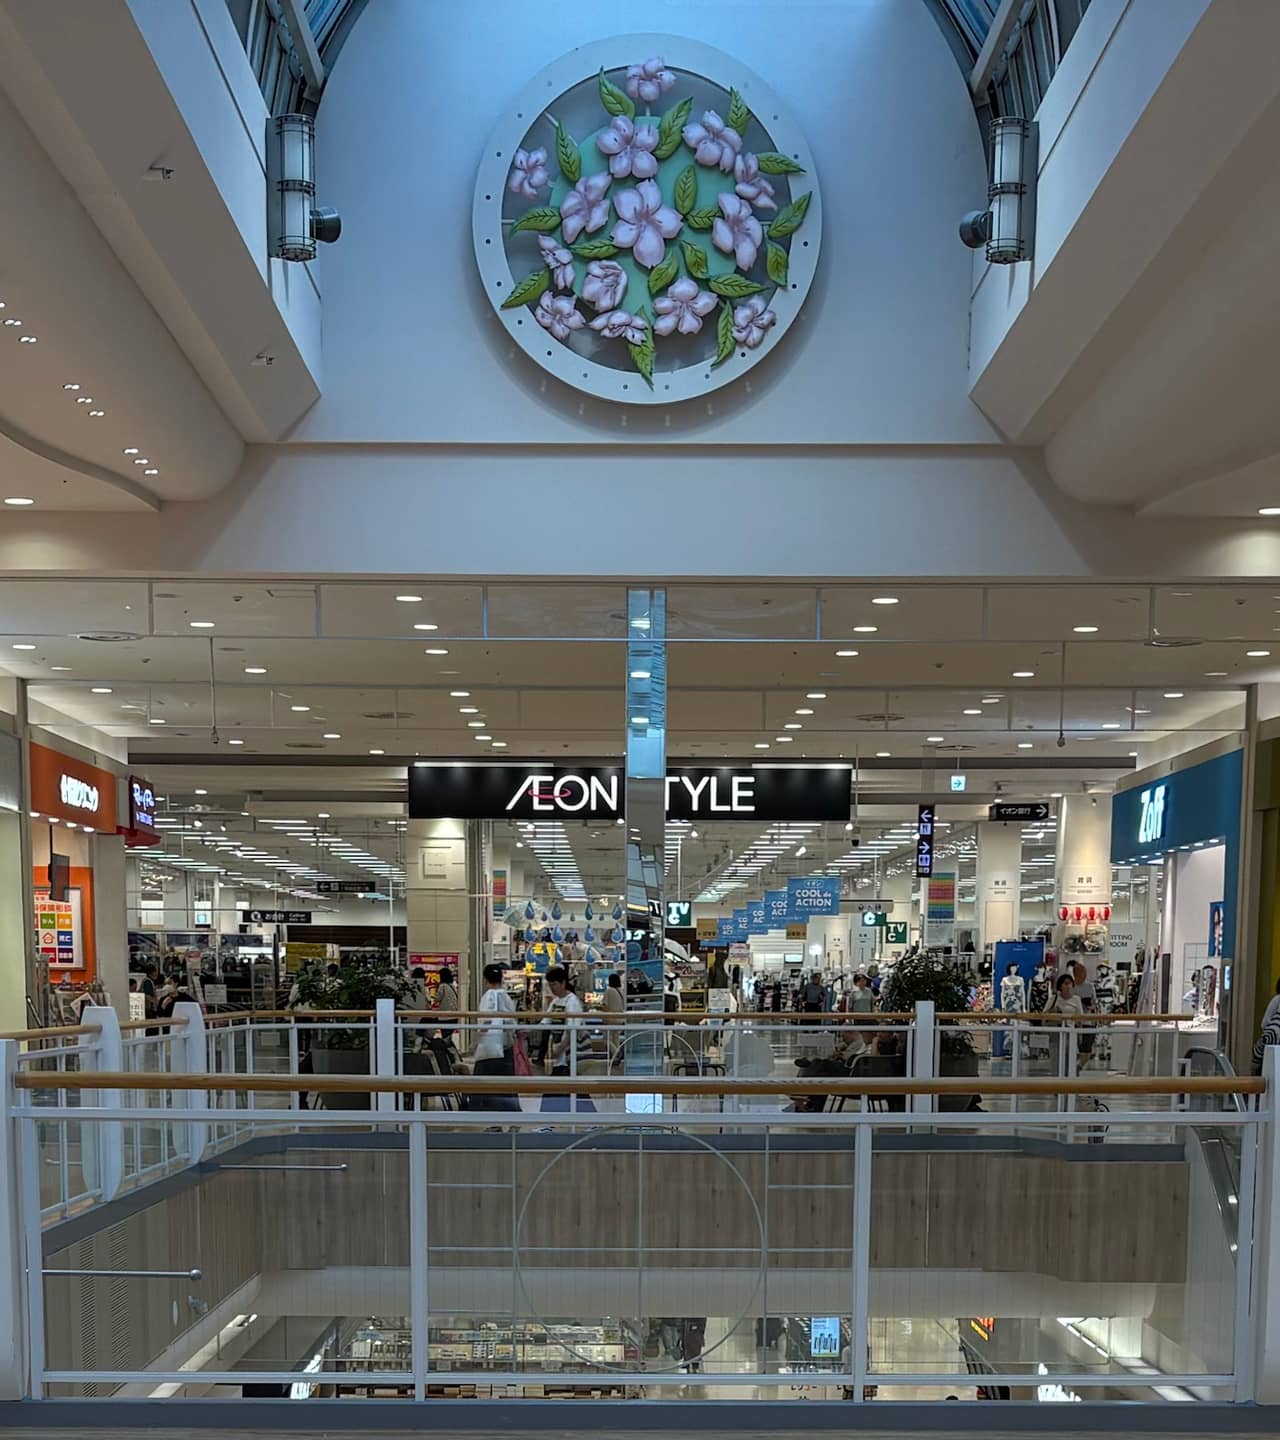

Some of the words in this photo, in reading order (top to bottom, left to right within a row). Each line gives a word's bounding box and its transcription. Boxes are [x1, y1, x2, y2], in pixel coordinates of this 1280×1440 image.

[665, 776, 756, 812] TYLE
[1137, 785, 1167, 844] Zoff
[794, 898, 832, 907] ACTION
[795, 889, 822, 898] COOL
